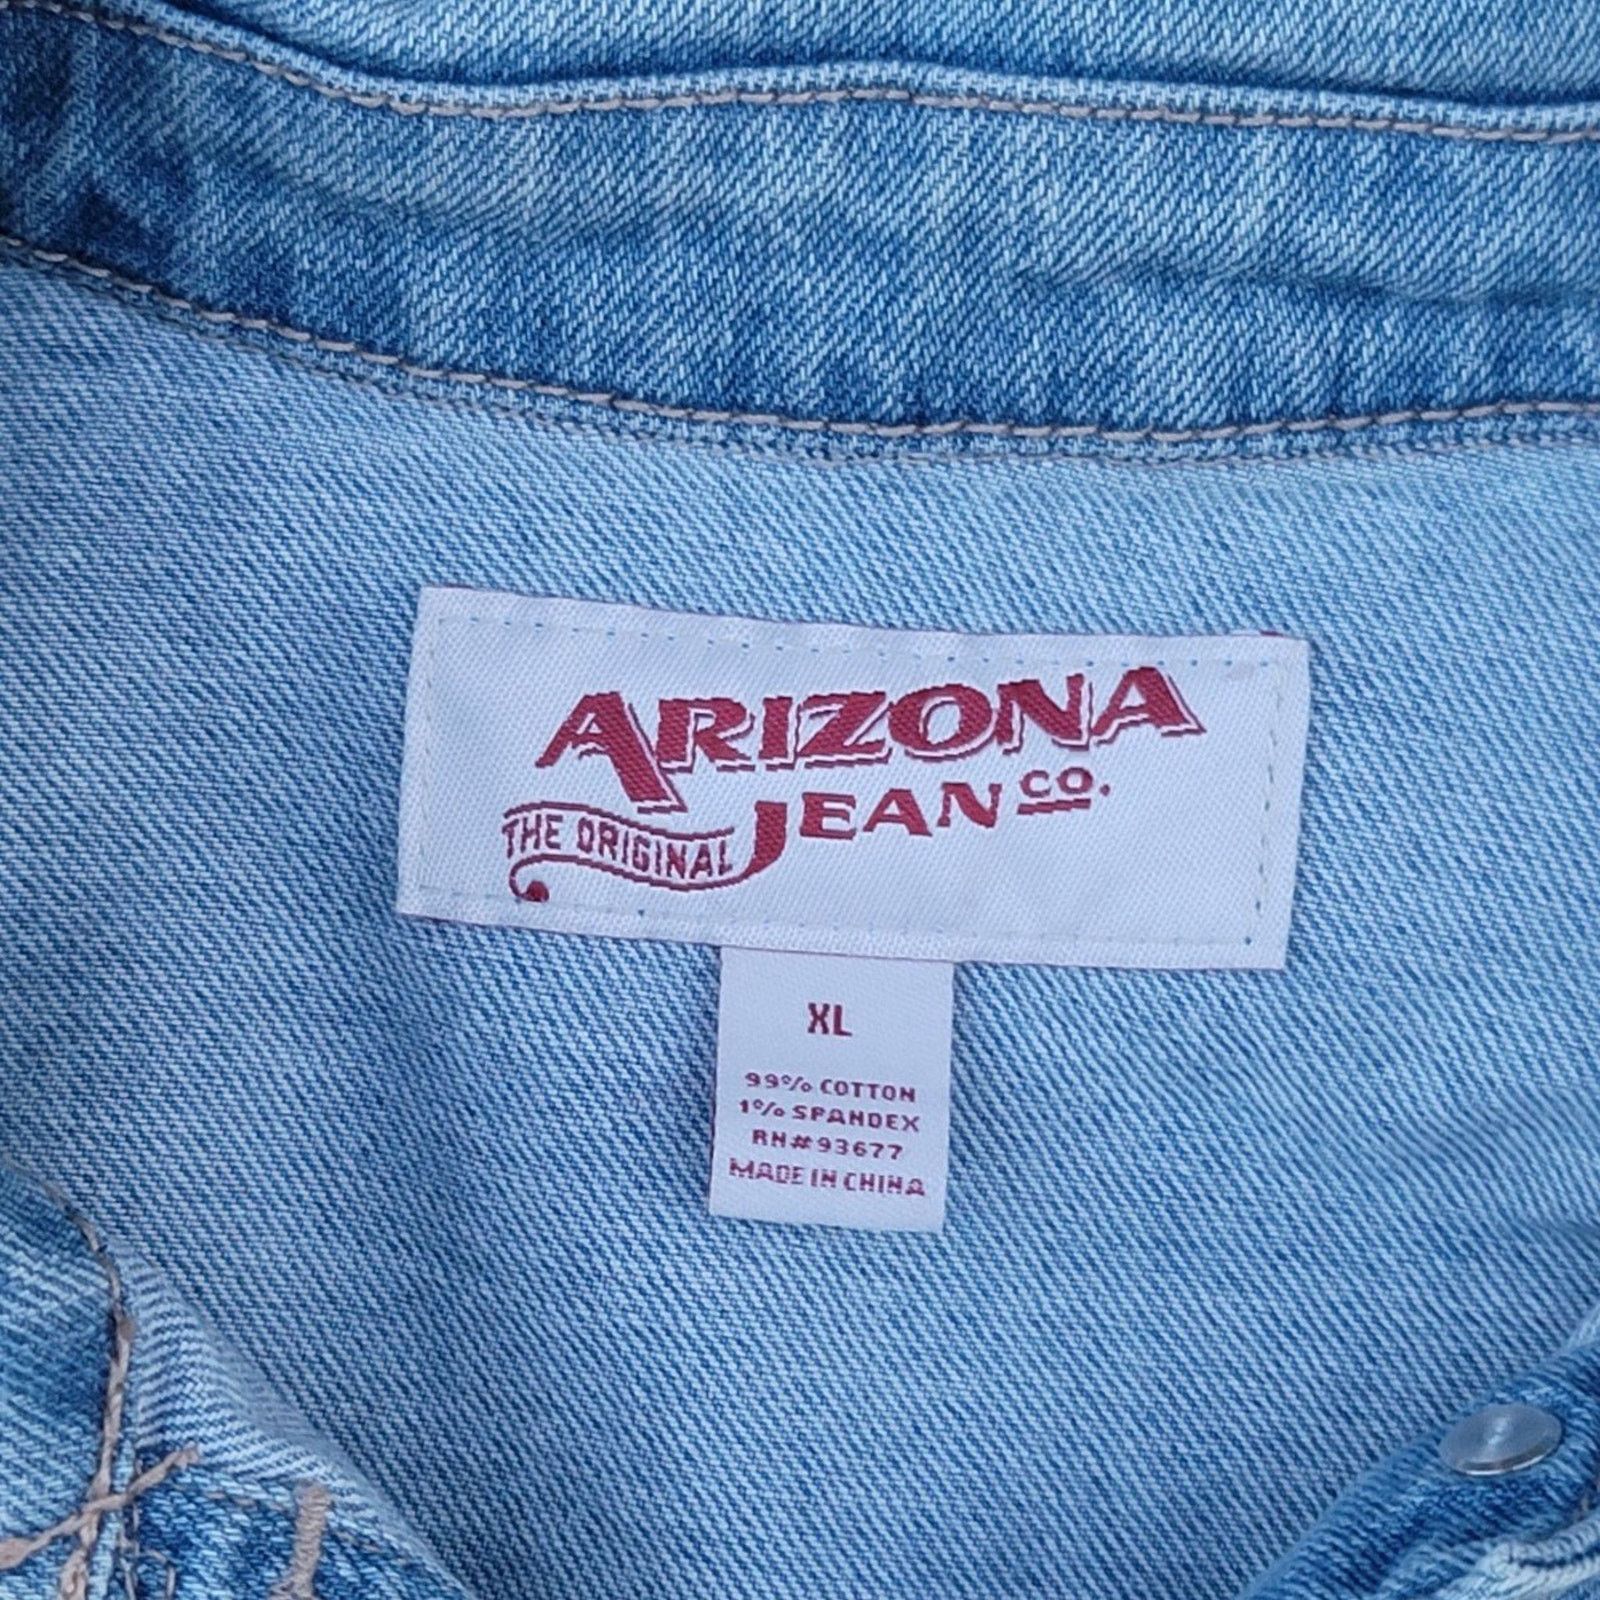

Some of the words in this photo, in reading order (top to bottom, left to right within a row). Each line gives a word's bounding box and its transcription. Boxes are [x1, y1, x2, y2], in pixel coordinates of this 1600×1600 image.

[535, 666, 1206, 814] ARIZONA
[737, 781, 1003, 880] JEAN
[1017, 766, 1112, 799] CO.
[502, 814, 562, 858] THE
[577, 818, 733, 879] ORIGINAL
[807, 1002, 853, 1036] XL
[745, 1072, 813, 1093] 99%
[820, 1078, 916, 1103] COTTON
[739, 1099, 786, 1117] 1%
[792, 1105, 920, 1132] SPANDEX
[752, 1129, 903, 1160] RN#93677
[729, 1158, 804, 1185] MADE
[811, 1168, 838, 1188] IN
[843, 1172, 925, 1197] CHINA
